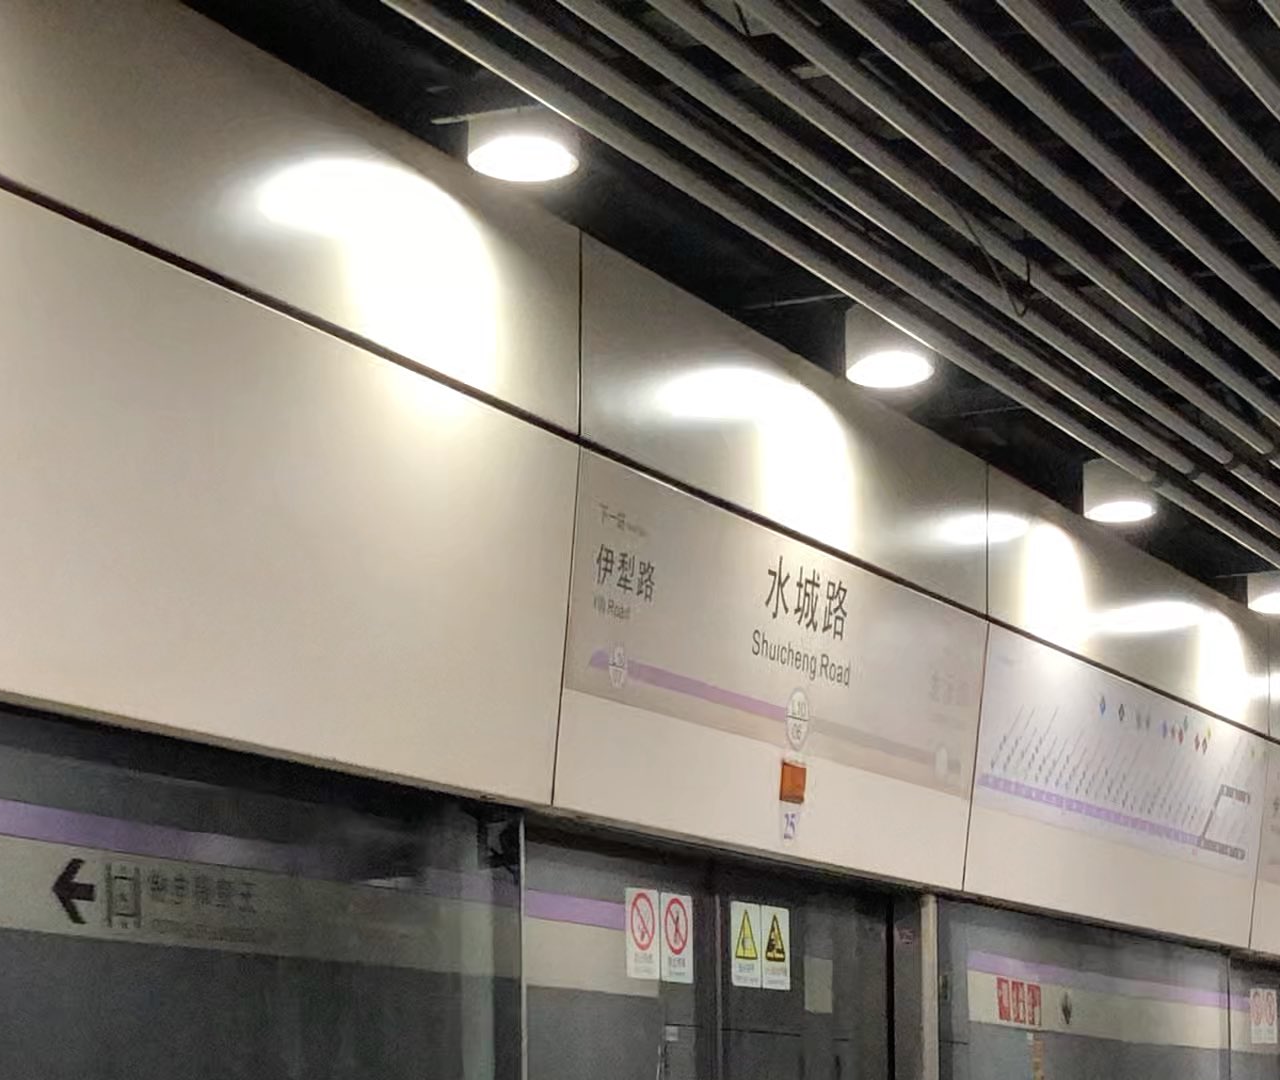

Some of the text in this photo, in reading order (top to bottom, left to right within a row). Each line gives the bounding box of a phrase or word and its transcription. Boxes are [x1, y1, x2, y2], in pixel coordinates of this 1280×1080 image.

[596, 543, 656, 603] 伊犁路
[765, 555, 848, 641] 水城路
[751, 629, 852, 687] Shuicheng Road
